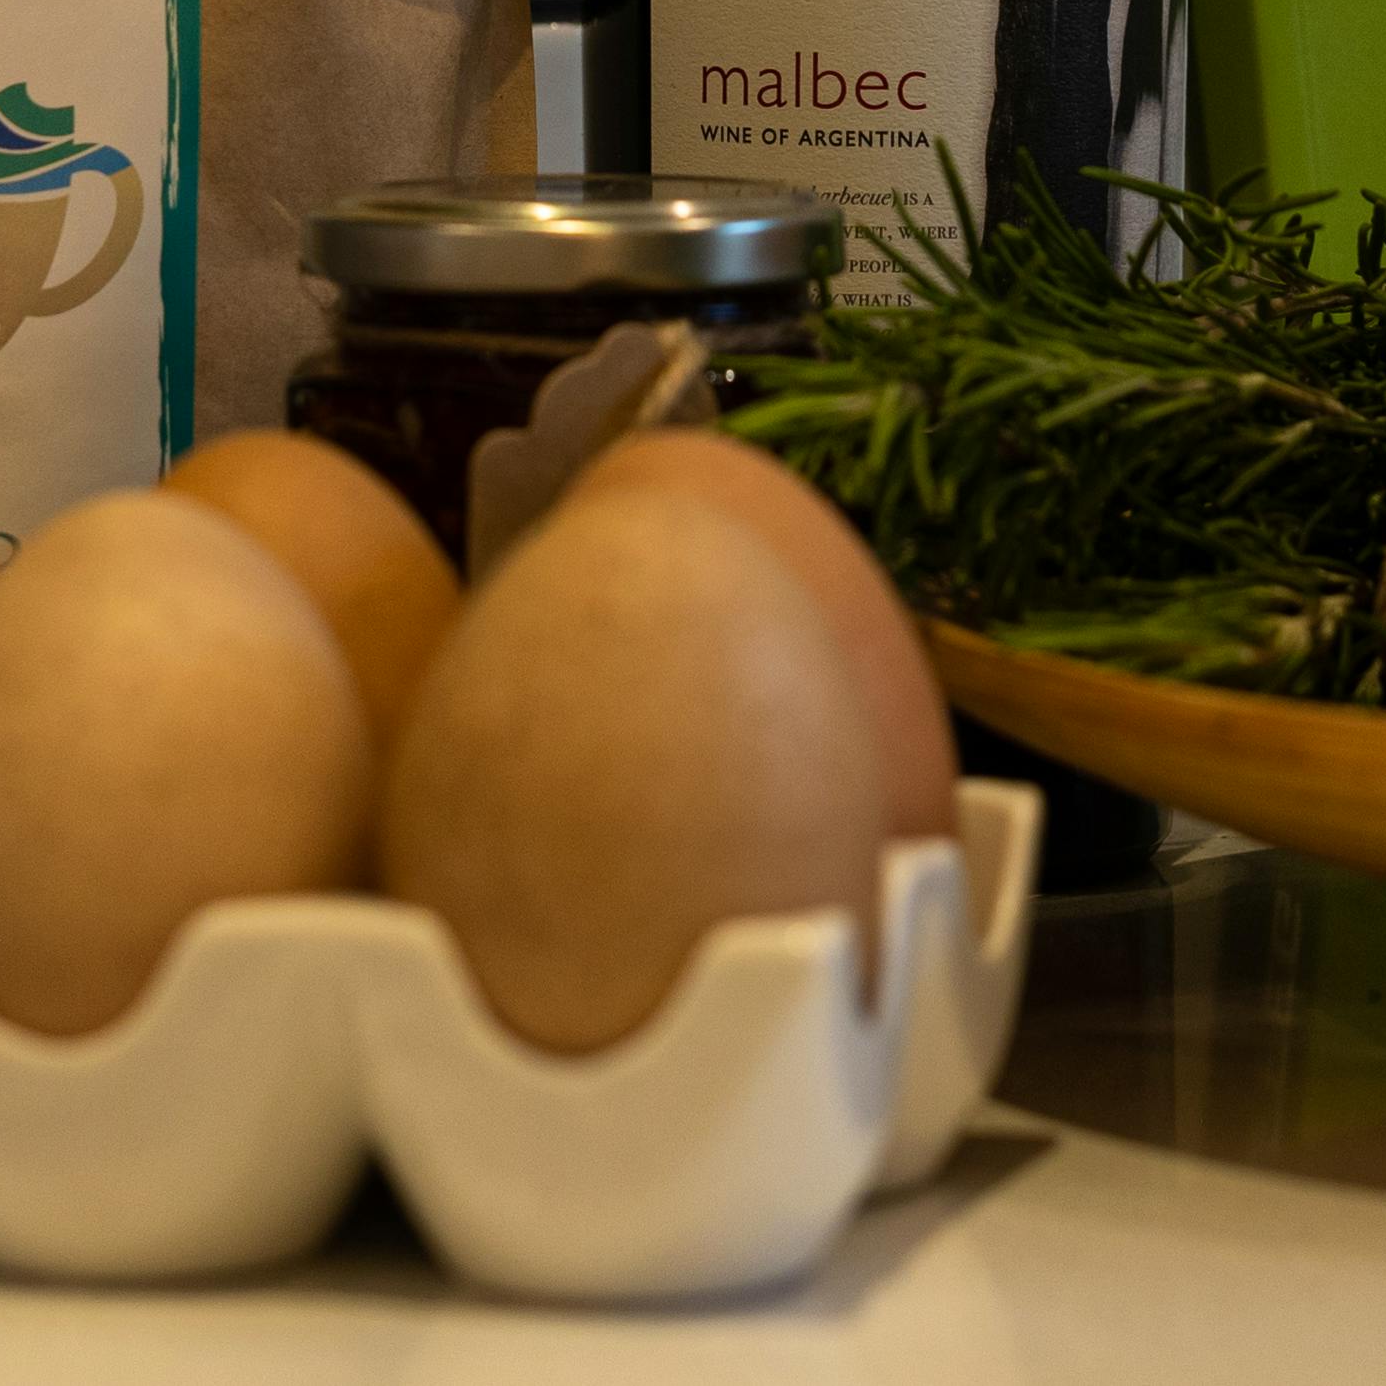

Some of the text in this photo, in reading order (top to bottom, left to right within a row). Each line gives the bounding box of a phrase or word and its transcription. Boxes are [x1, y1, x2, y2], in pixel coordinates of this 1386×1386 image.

[702, 51, 927, 111] malbec
[700, 124, 930, 148] WINE OF ARGENTINA
[903, 192, 918, 206] IS
[923, 192, 934, 206] A
[843, 225, 892, 242] VENT,
[843, 293, 892, 307] WHAT
[898, 293, 912, 307] IS
